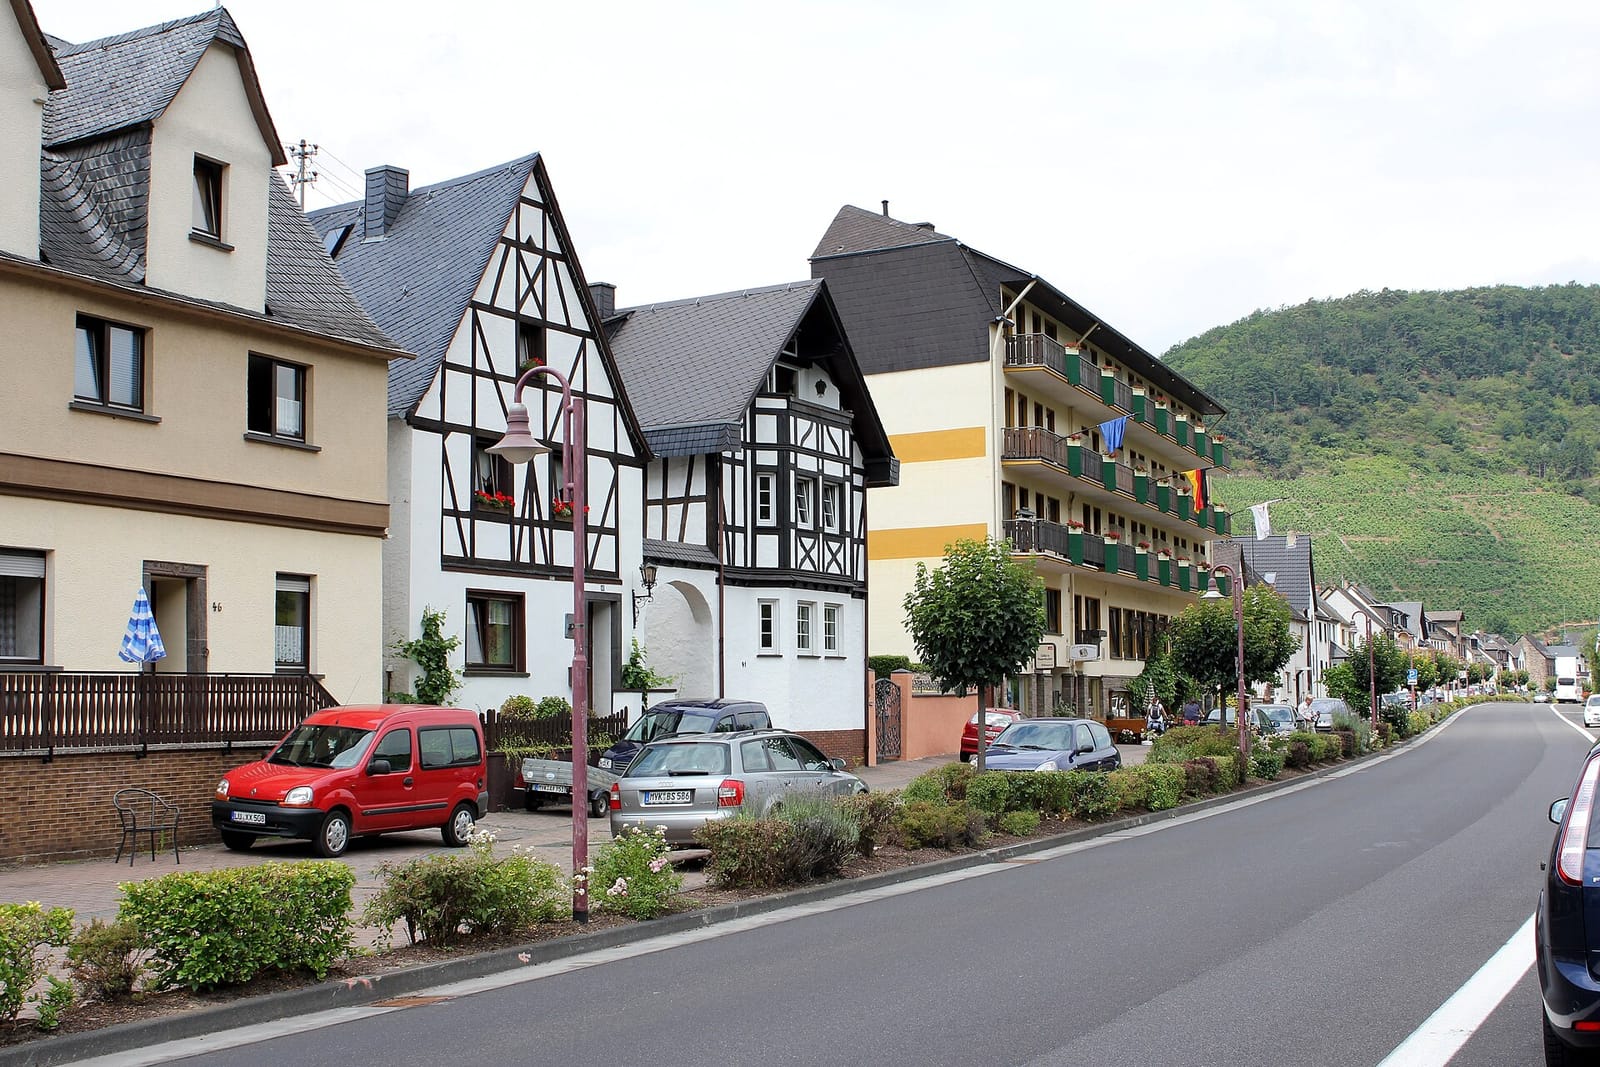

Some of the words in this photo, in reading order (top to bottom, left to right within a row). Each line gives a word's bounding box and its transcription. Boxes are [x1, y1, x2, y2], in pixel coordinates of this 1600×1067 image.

[212, 601, 222, 612] 46
[649, 791, 663, 801] MYK
[666, 792, 676, 801] BS
